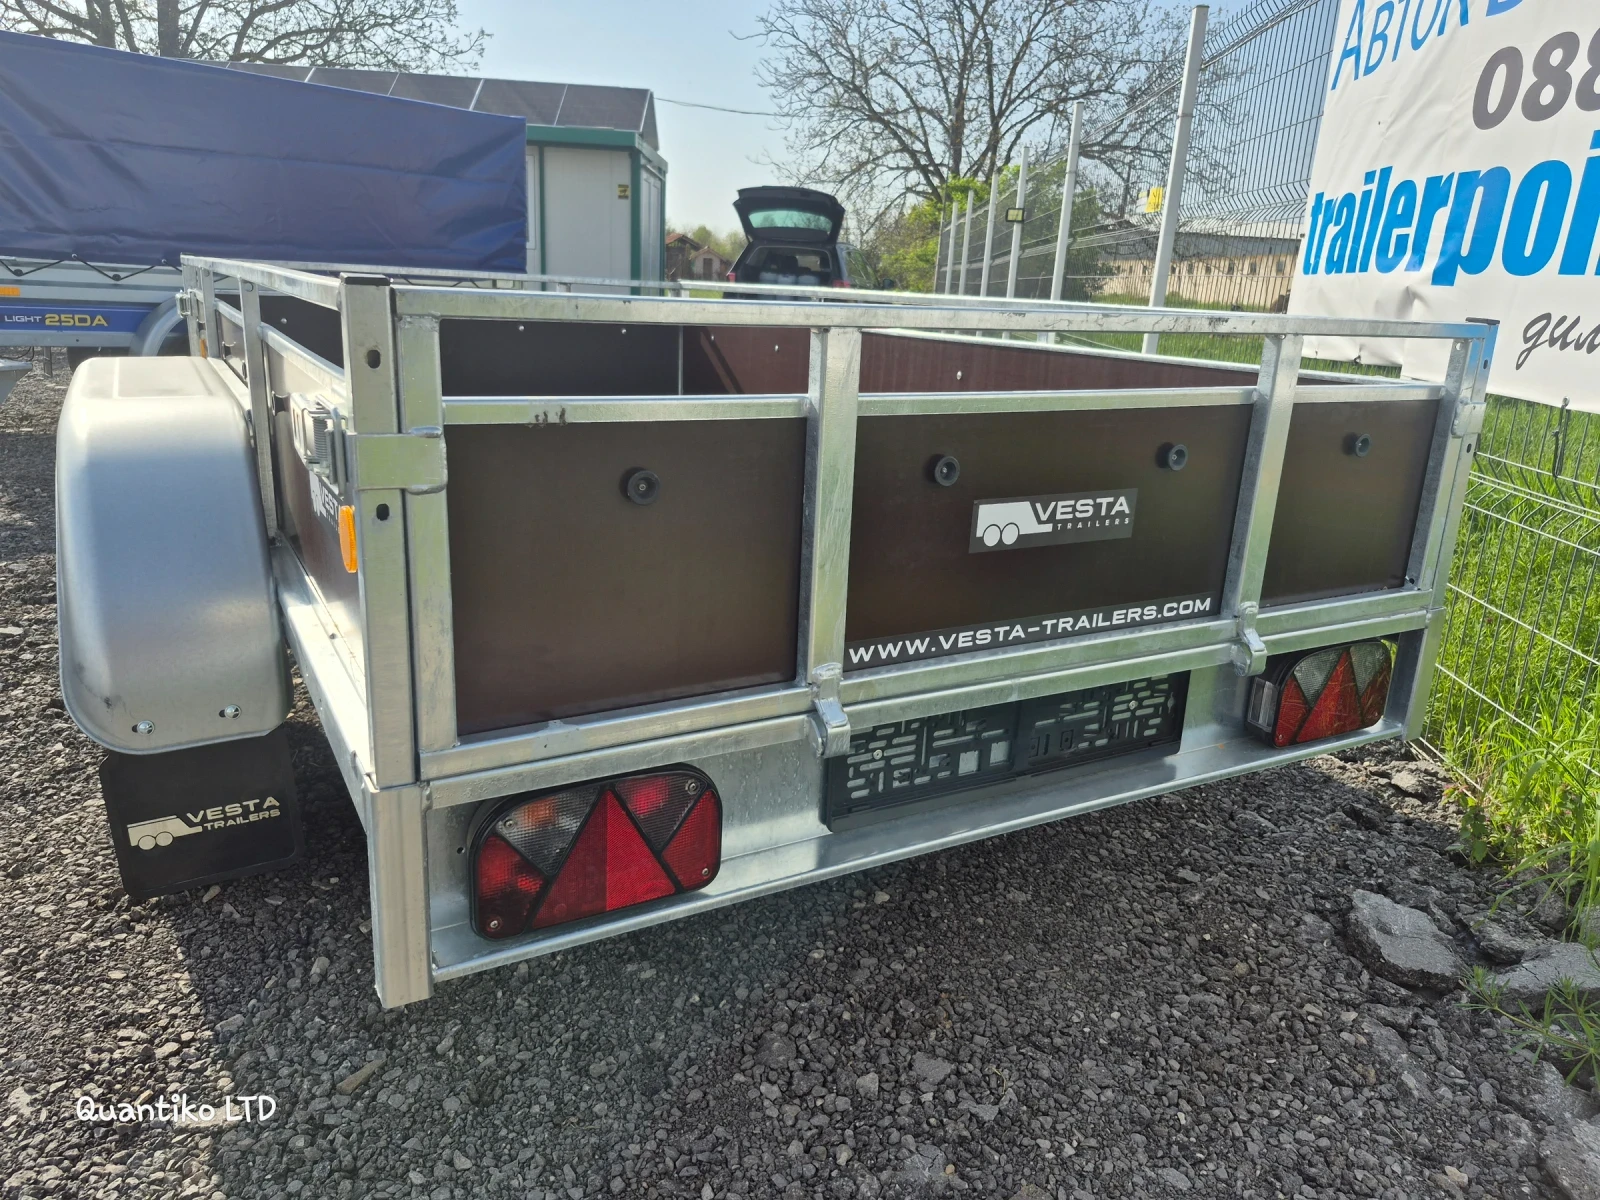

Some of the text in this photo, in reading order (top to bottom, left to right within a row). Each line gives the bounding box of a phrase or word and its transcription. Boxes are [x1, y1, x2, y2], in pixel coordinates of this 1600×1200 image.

[1303, 129, 1600, 287] trailerpoi
[4, 313, 108, 327] LIGHT 25DA
[1035, 496, 1131, 521] VESTA
[1057, 517, 1130, 531] TRAILERS
[848, 597, 1212, 664] WWW.VESTA-TRAILERS.COM
[186, 796, 280, 823] VESTA
[203, 808, 281, 831] TRAILERS
